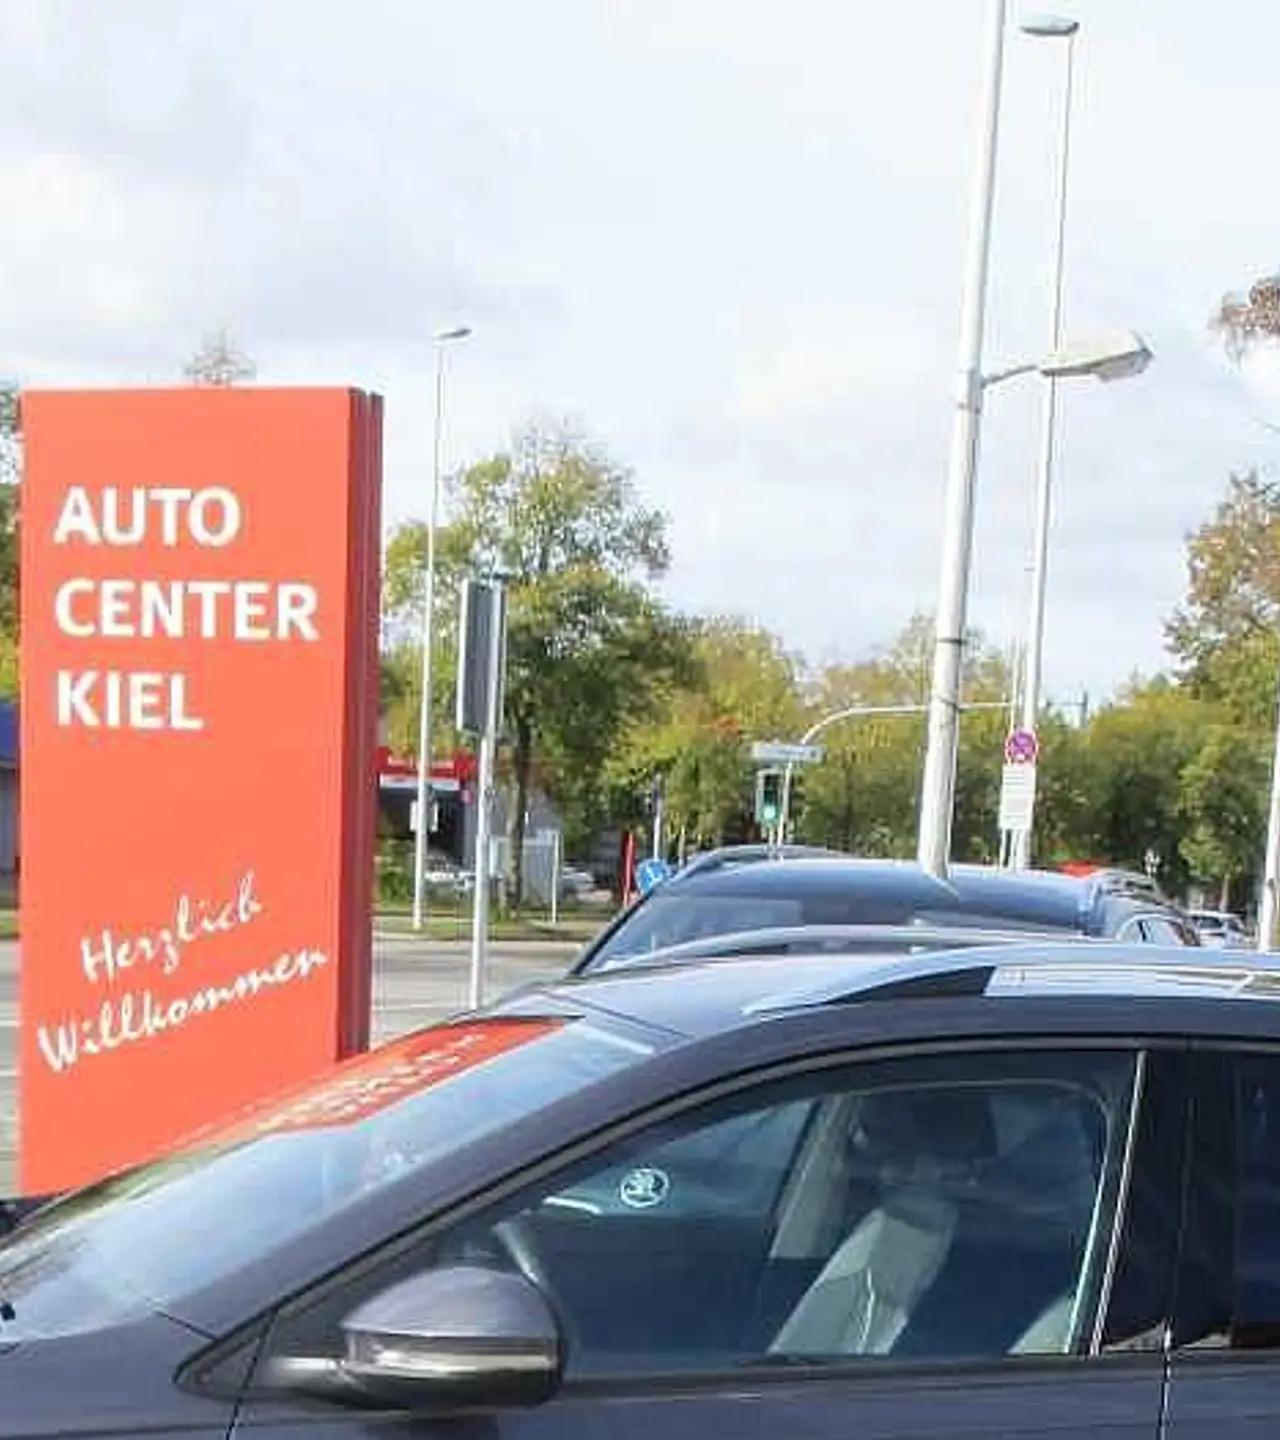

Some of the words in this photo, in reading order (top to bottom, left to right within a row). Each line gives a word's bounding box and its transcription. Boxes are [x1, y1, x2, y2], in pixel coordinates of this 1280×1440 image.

[53, 485, 241, 546] AUTO
[55, 577, 320, 641] CENTER
[57, 669, 205, 731] KIEL
[81, 869, 264, 984] Herzlich
[37, 948, 328, 1073] Willkommen
